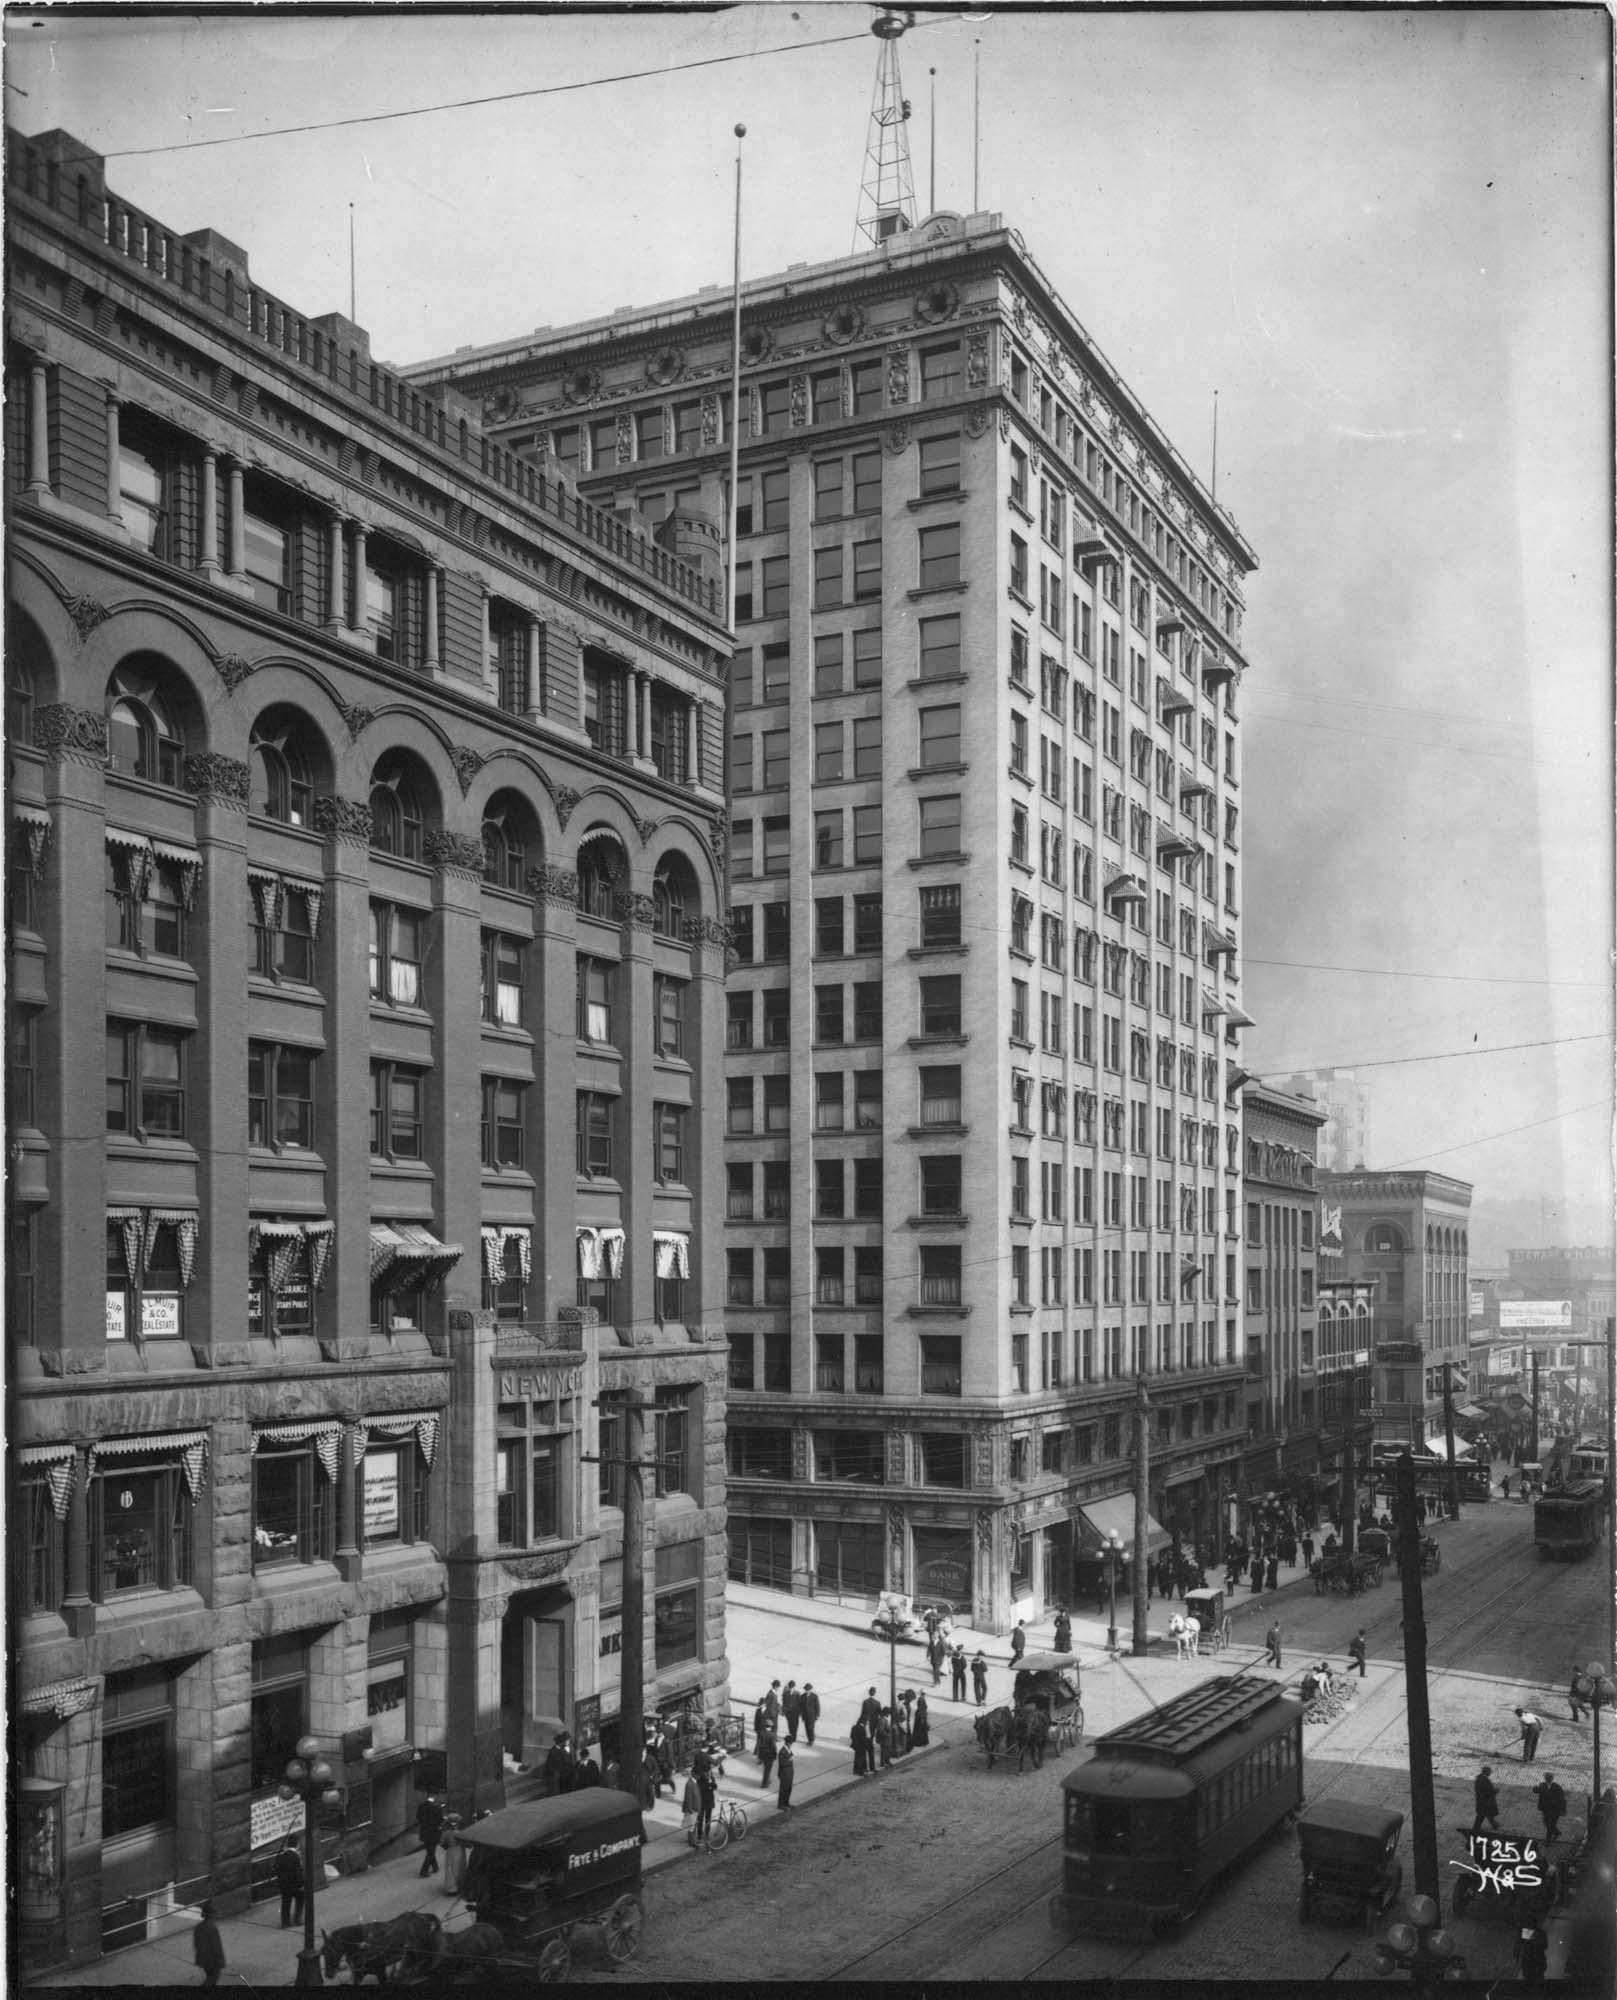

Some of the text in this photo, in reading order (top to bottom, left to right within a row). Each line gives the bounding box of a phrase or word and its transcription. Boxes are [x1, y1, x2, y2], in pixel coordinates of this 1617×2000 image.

[279, 1285, 308, 1294] URANCE
[107, 1300, 122, 1314] UIR
[501, 1373, 549, 1397] NEW
